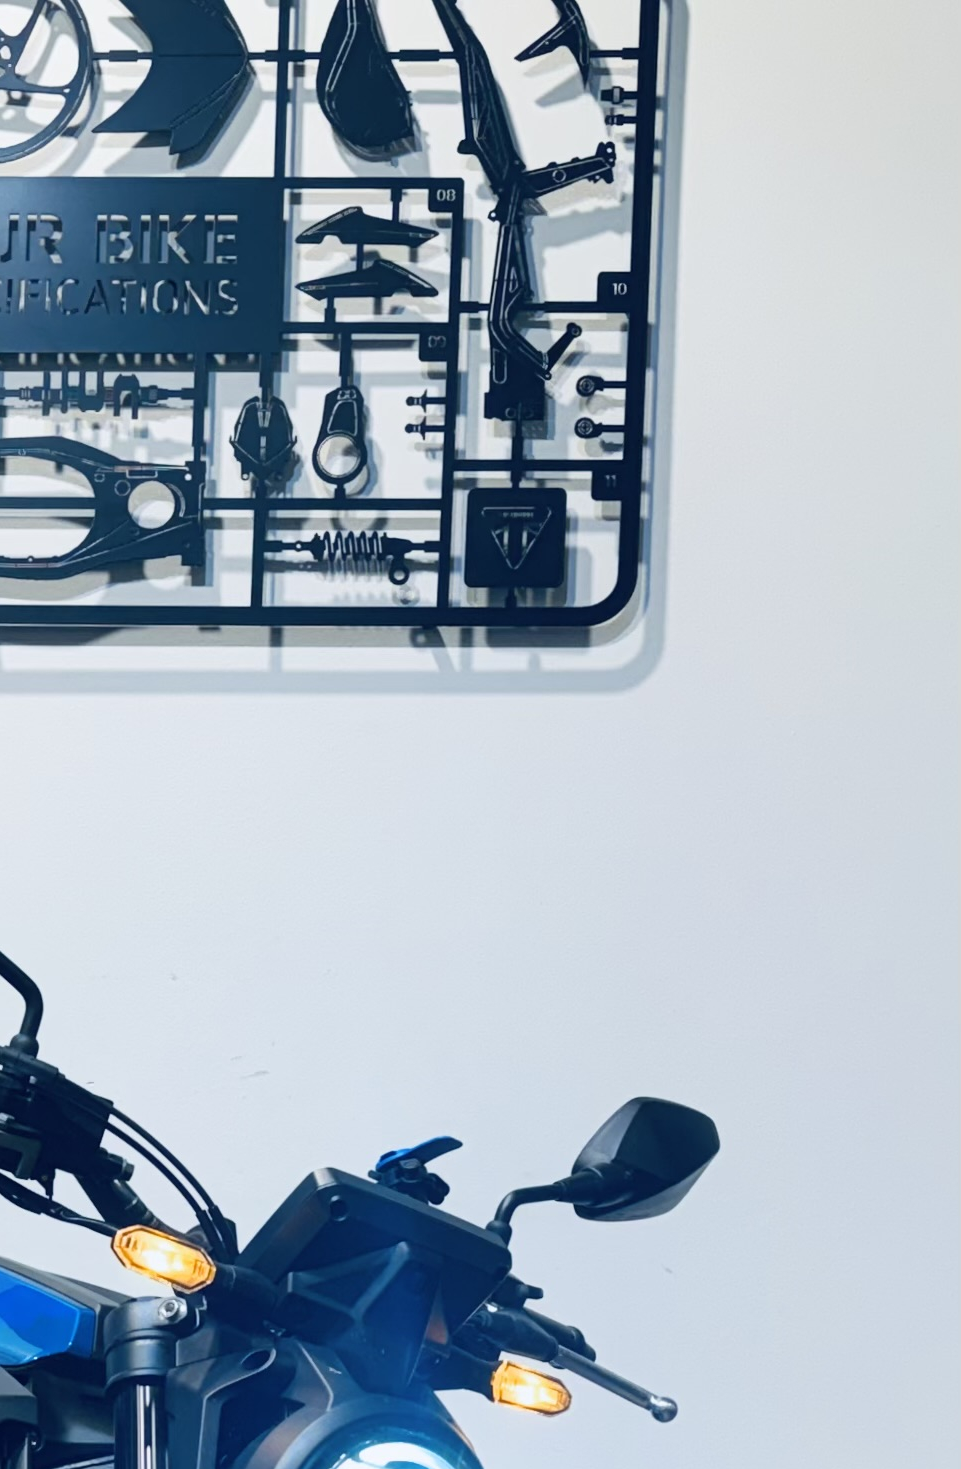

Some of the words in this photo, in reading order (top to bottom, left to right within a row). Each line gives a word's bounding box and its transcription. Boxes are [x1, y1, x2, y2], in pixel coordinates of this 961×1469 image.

[436, 188, 457, 202] 08
[95, 213, 239, 265] BIKE
[612, 282, 628, 296] 10
